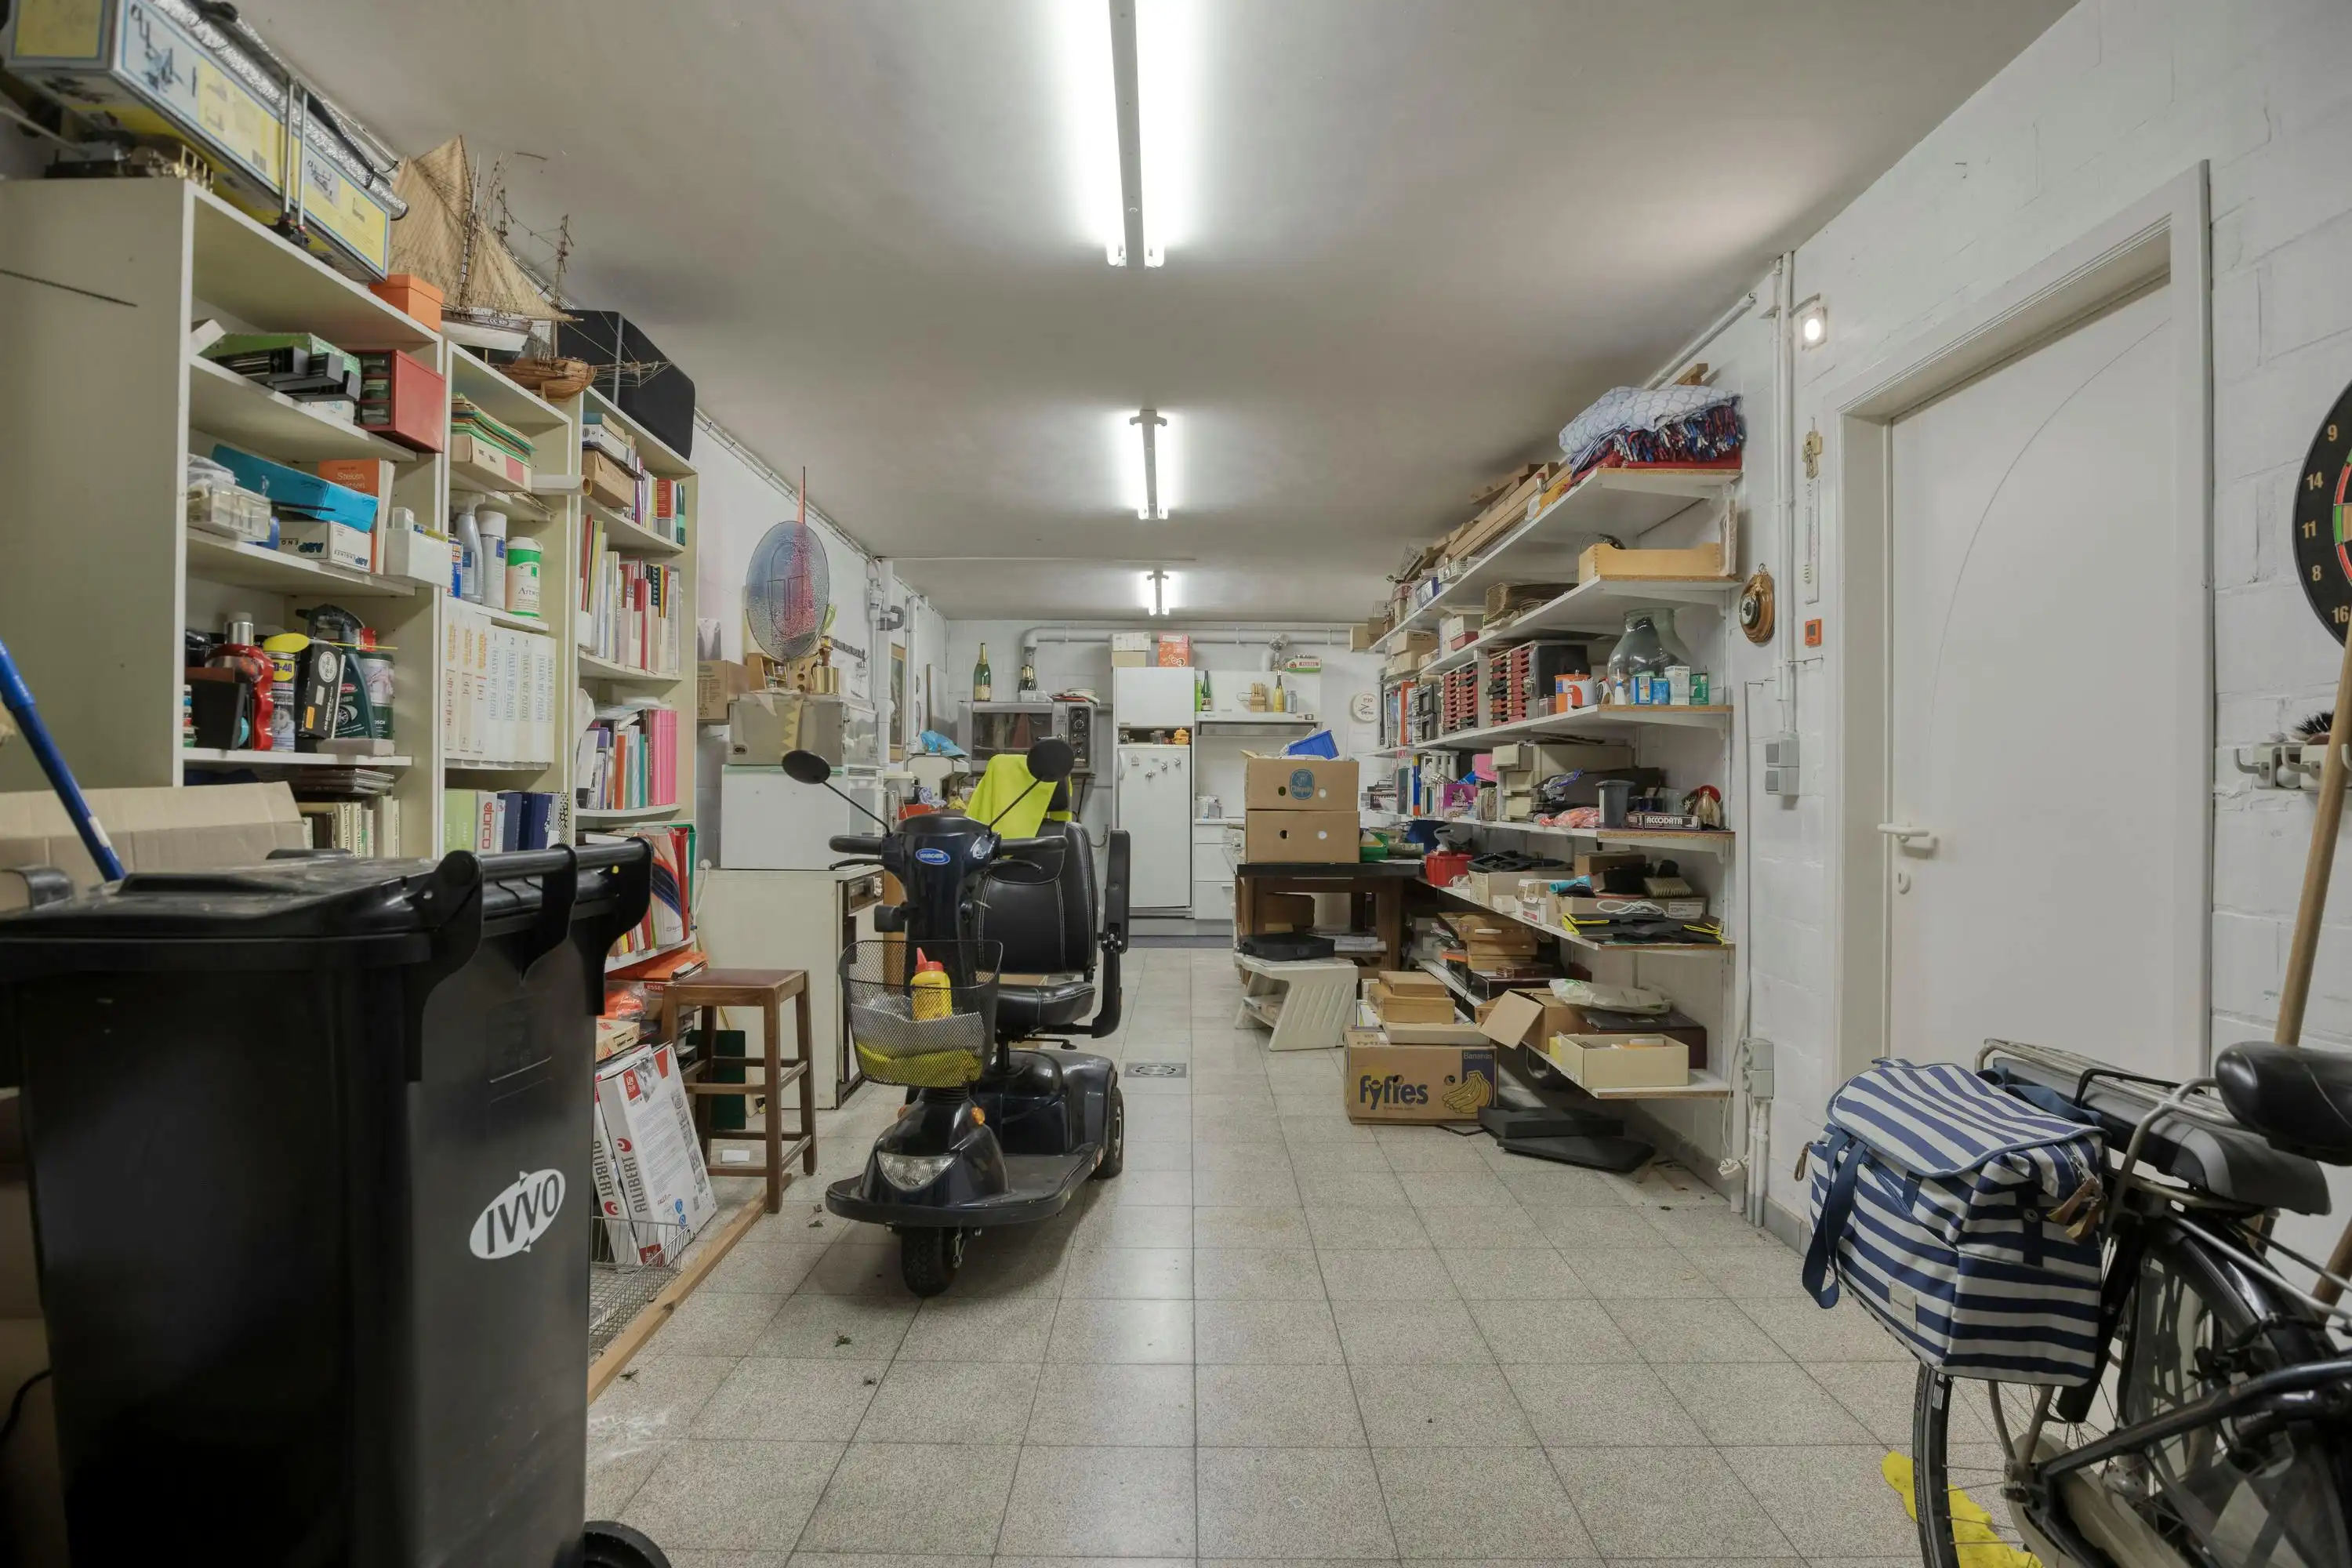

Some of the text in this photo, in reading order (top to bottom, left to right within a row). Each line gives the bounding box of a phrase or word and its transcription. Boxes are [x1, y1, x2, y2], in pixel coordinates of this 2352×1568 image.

[2327, 425, 2339, 441] 9
[2307, 472, 2324, 491] 14
[2302, 521, 2317, 539] 11
[2312, 565, 2322, 581] 8
[2332, 606, 2349, 623] 16
[274, 662, 292, 672] D-40
